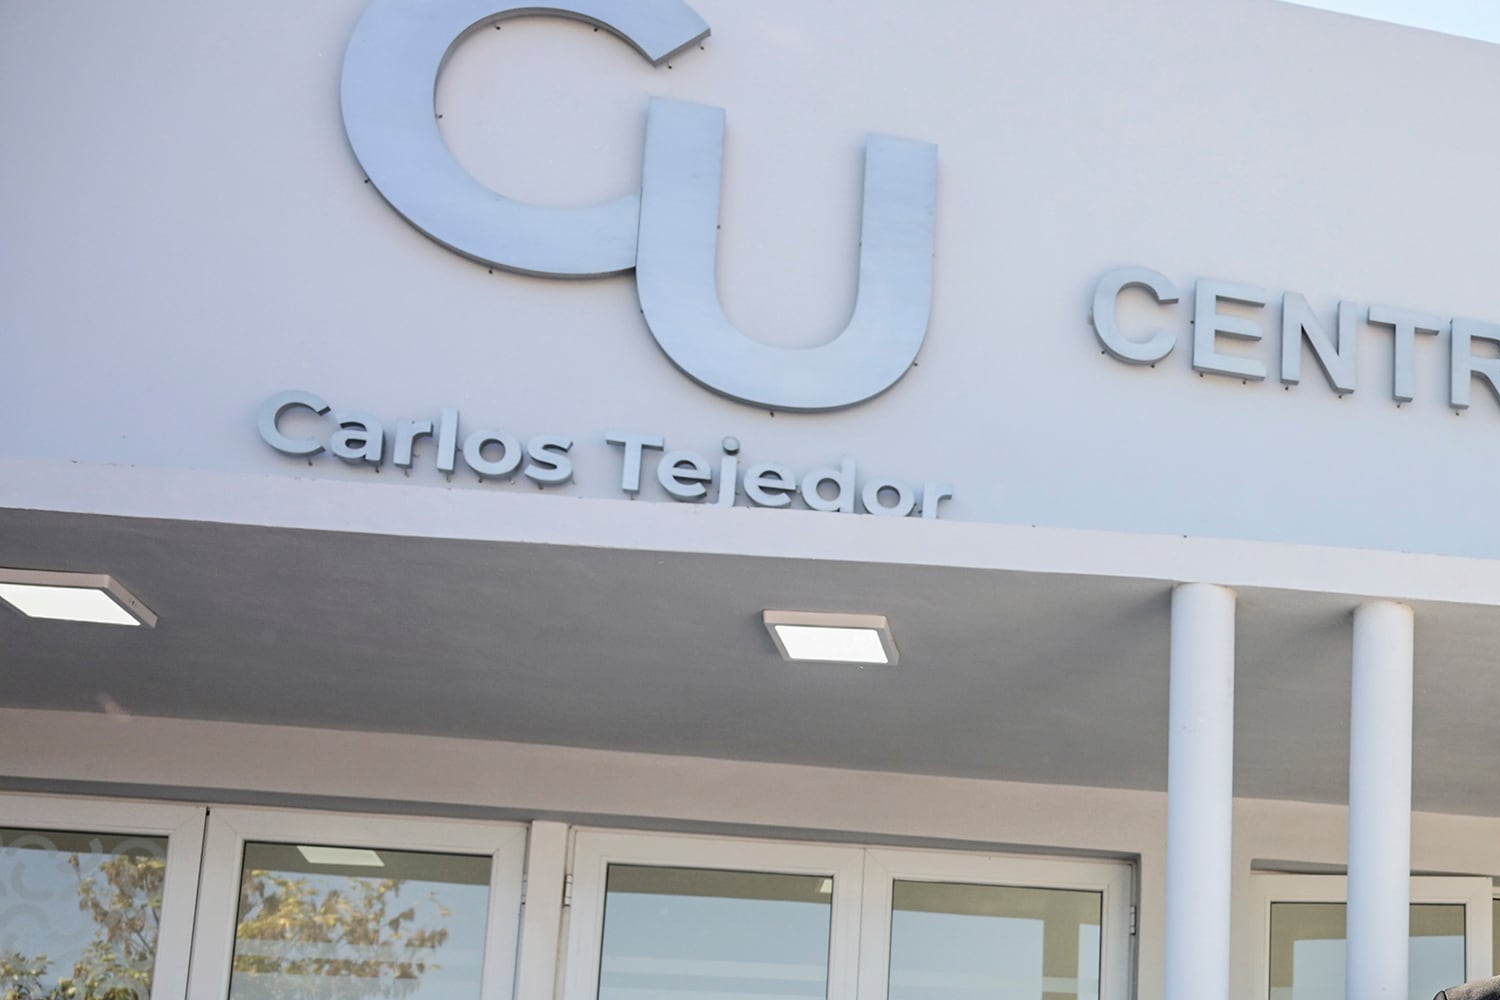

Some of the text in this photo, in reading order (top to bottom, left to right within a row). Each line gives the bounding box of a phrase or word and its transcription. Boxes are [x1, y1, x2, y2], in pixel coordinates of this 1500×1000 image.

[340, 0, 939, 414] CU
[257, 389, 953, 520] Carlos Tejedor
